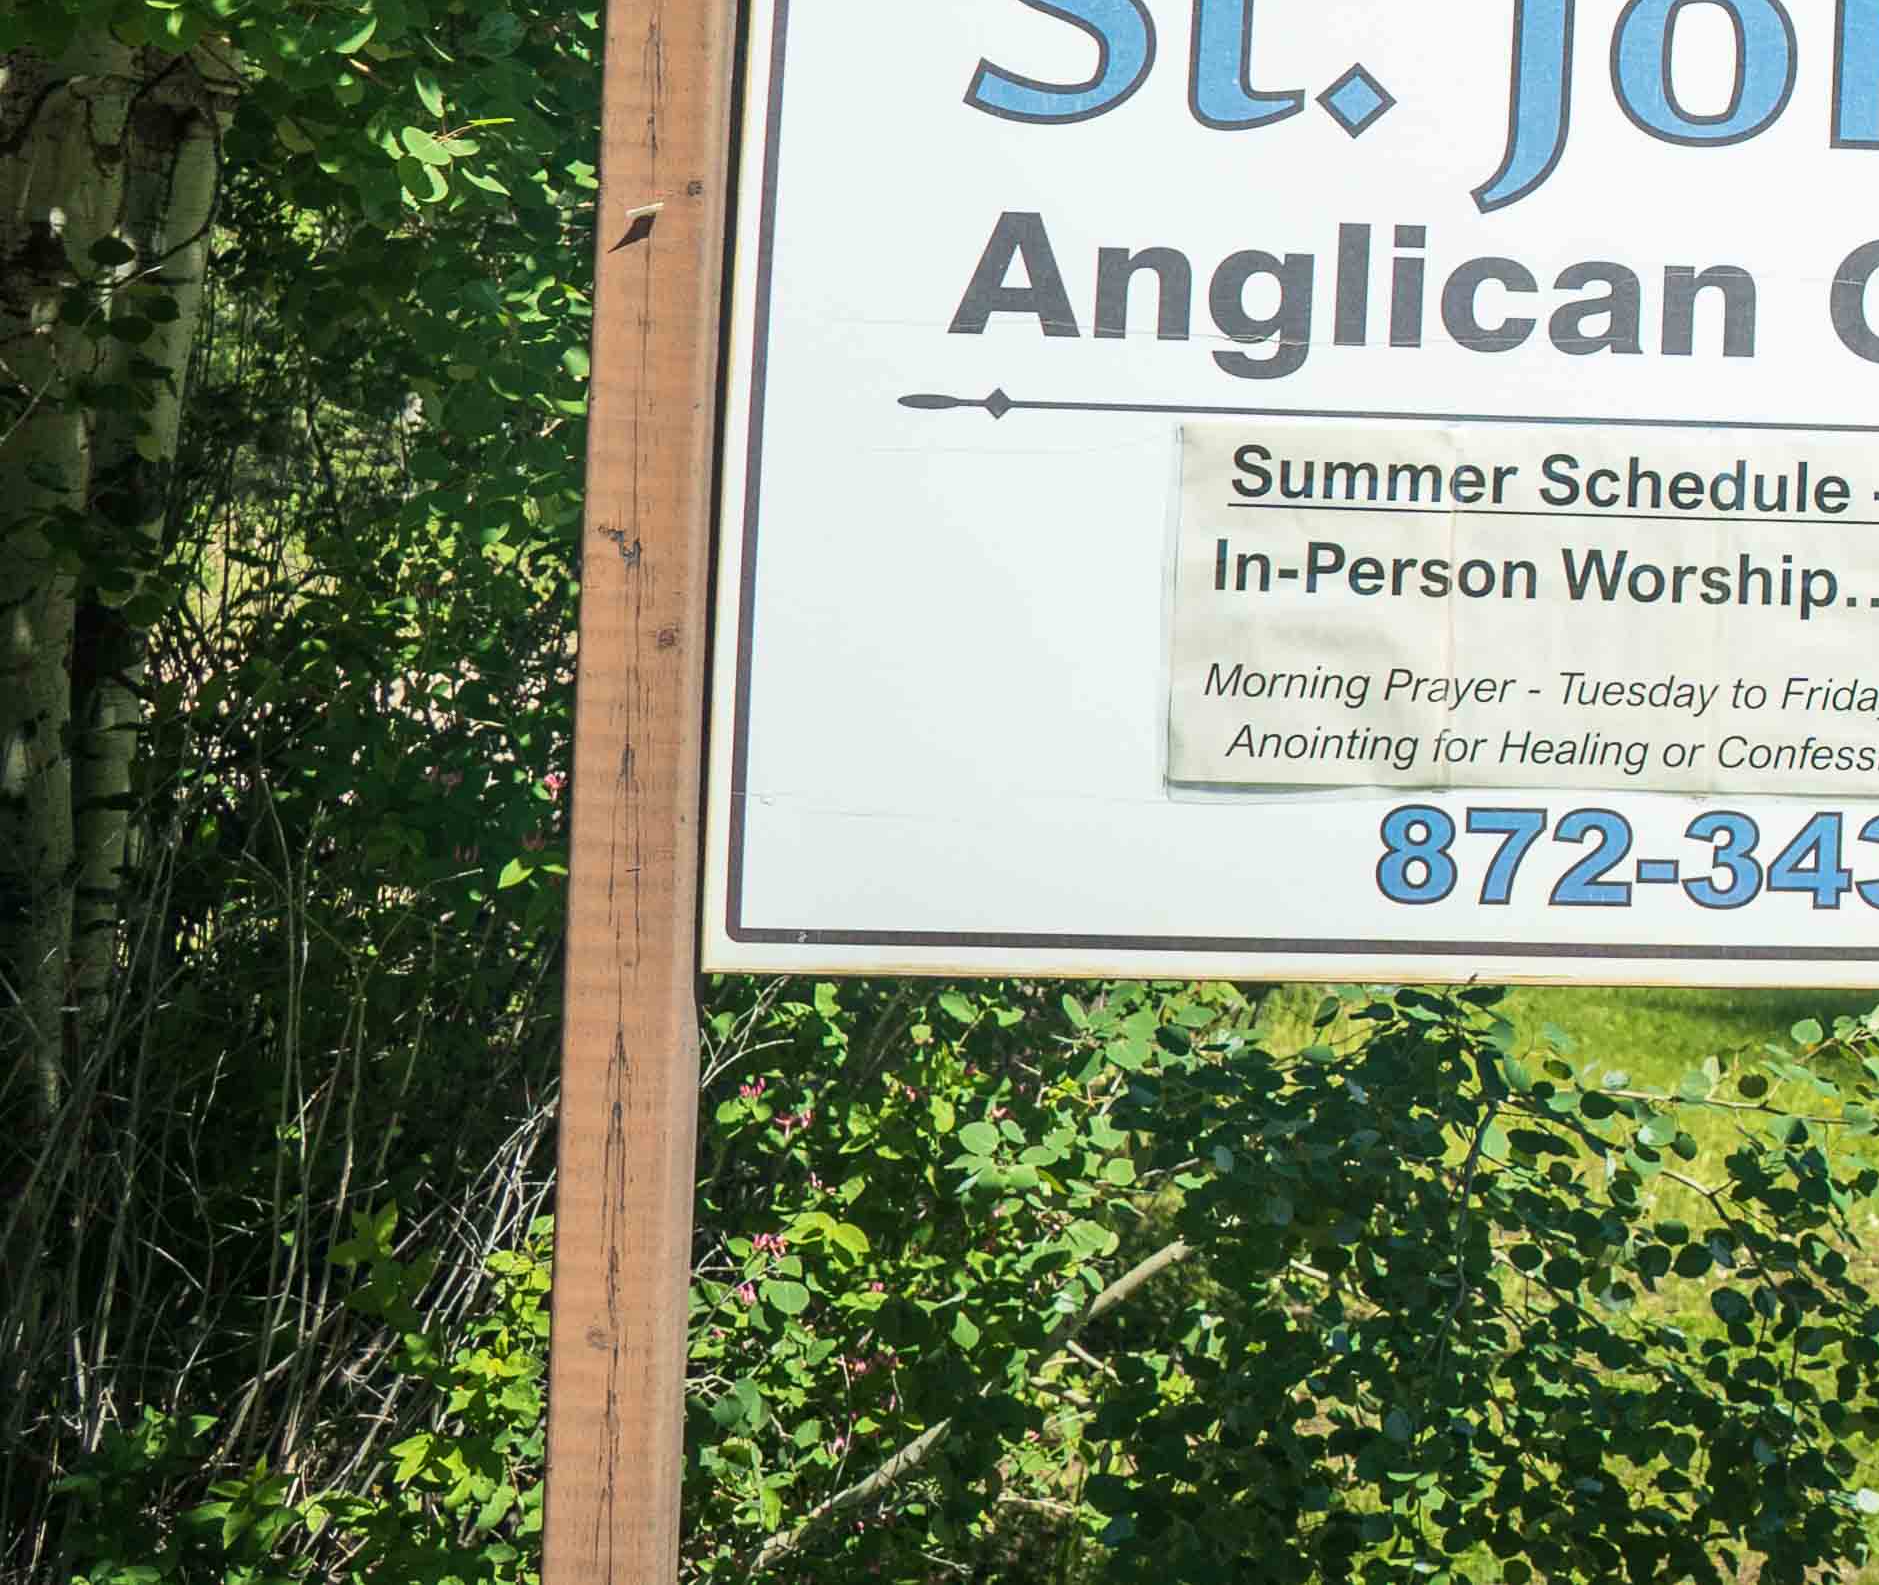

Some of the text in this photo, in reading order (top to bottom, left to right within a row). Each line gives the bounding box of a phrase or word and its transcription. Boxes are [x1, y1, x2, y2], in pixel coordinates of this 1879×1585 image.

[948, 210, 1757, 380] Anglican
[1231, 444, 1519, 505] Summer
[1538, 453, 1851, 515] Schedule
[1214, 538, 1537, 599] In-Person
[1204, 662, 1371, 709] Morning
[1383, 668, 1517, 711] Prayer
[1560, 672, 1719, 718] Tuesday
[1732, 677, 1767, 710] to
[1225, 725, 1420, 771] Anointing
[1432, 728, 1489, 763] for
[1498, 730, 1649, 776] Healing
[1662, 743, 1705, 768] or
